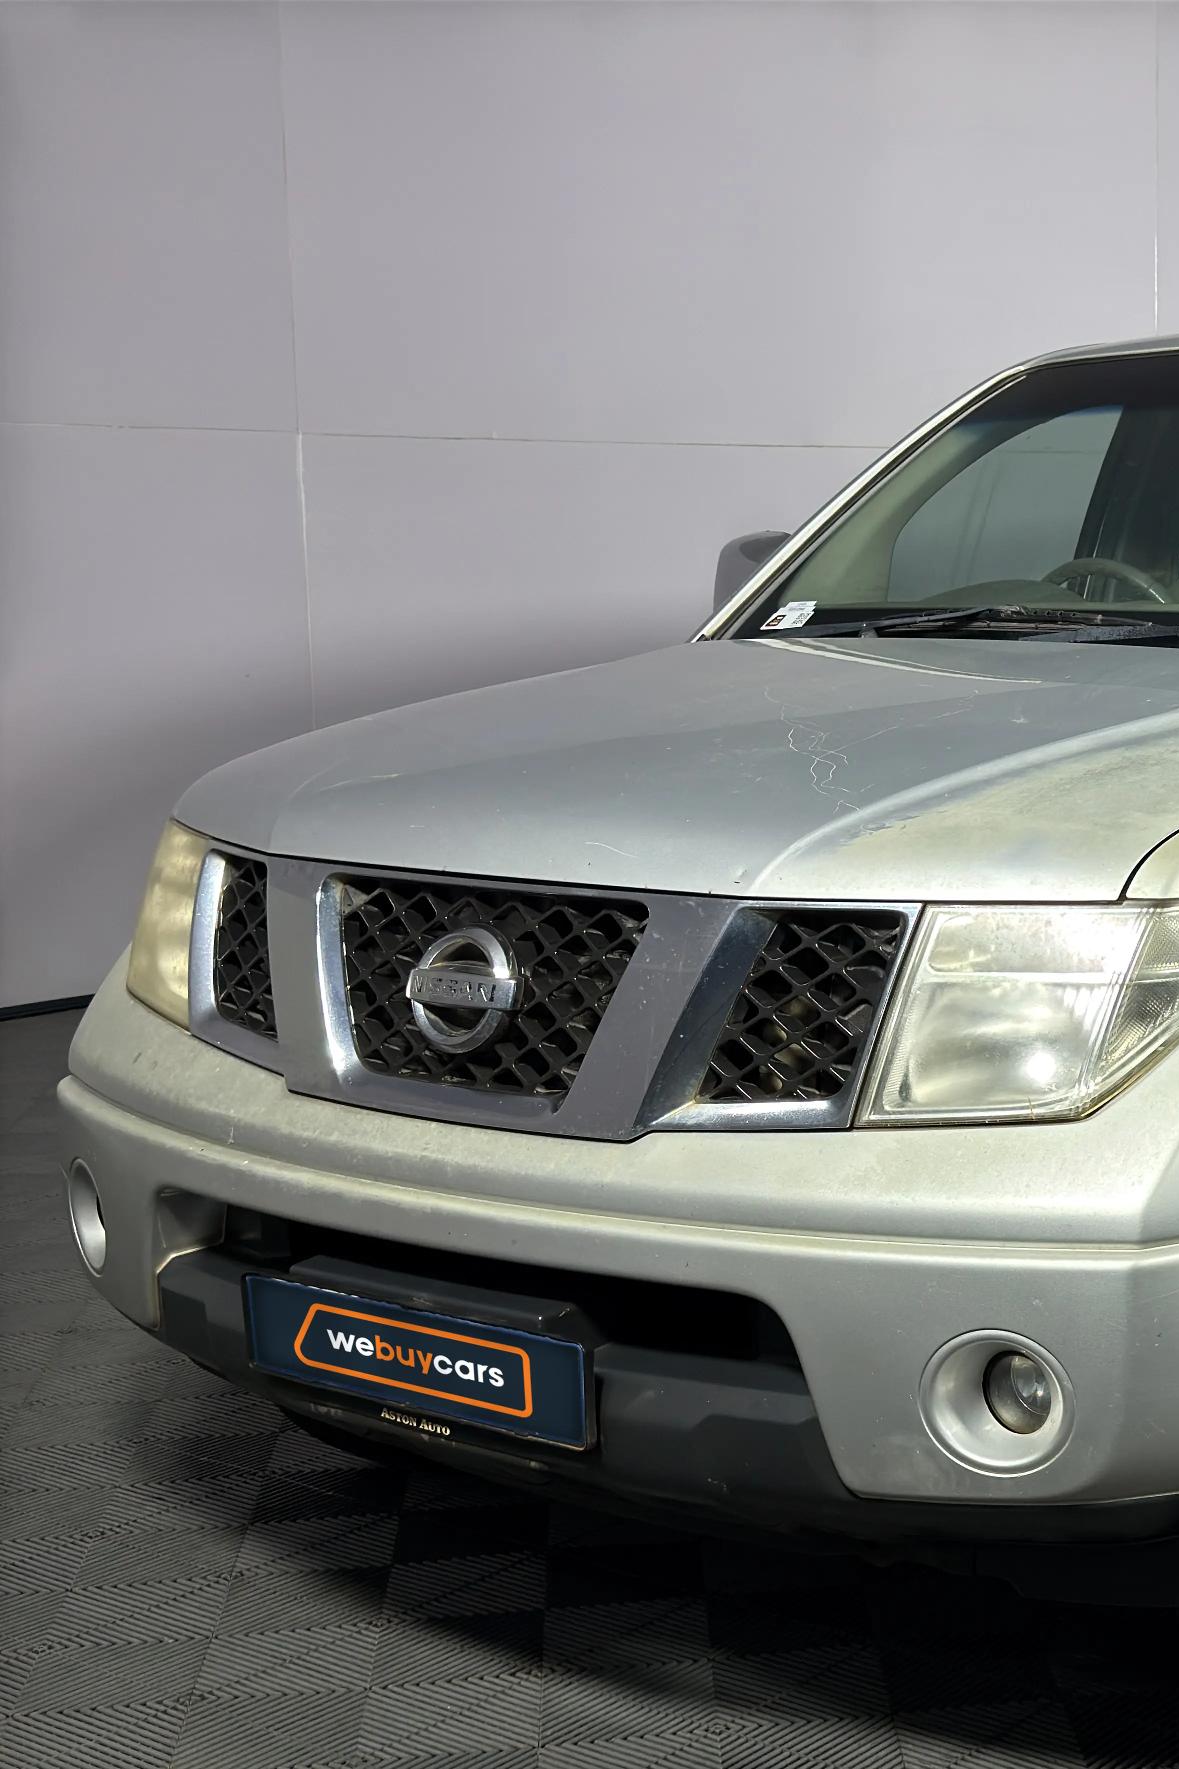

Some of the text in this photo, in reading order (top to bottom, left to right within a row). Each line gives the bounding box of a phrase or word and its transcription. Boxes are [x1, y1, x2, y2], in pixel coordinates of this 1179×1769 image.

[412, 974, 497, 1002] NISSAN
[326, 1328, 505, 1388] webuycars
[380, 1407, 451, 1436] ASTON AUTO
